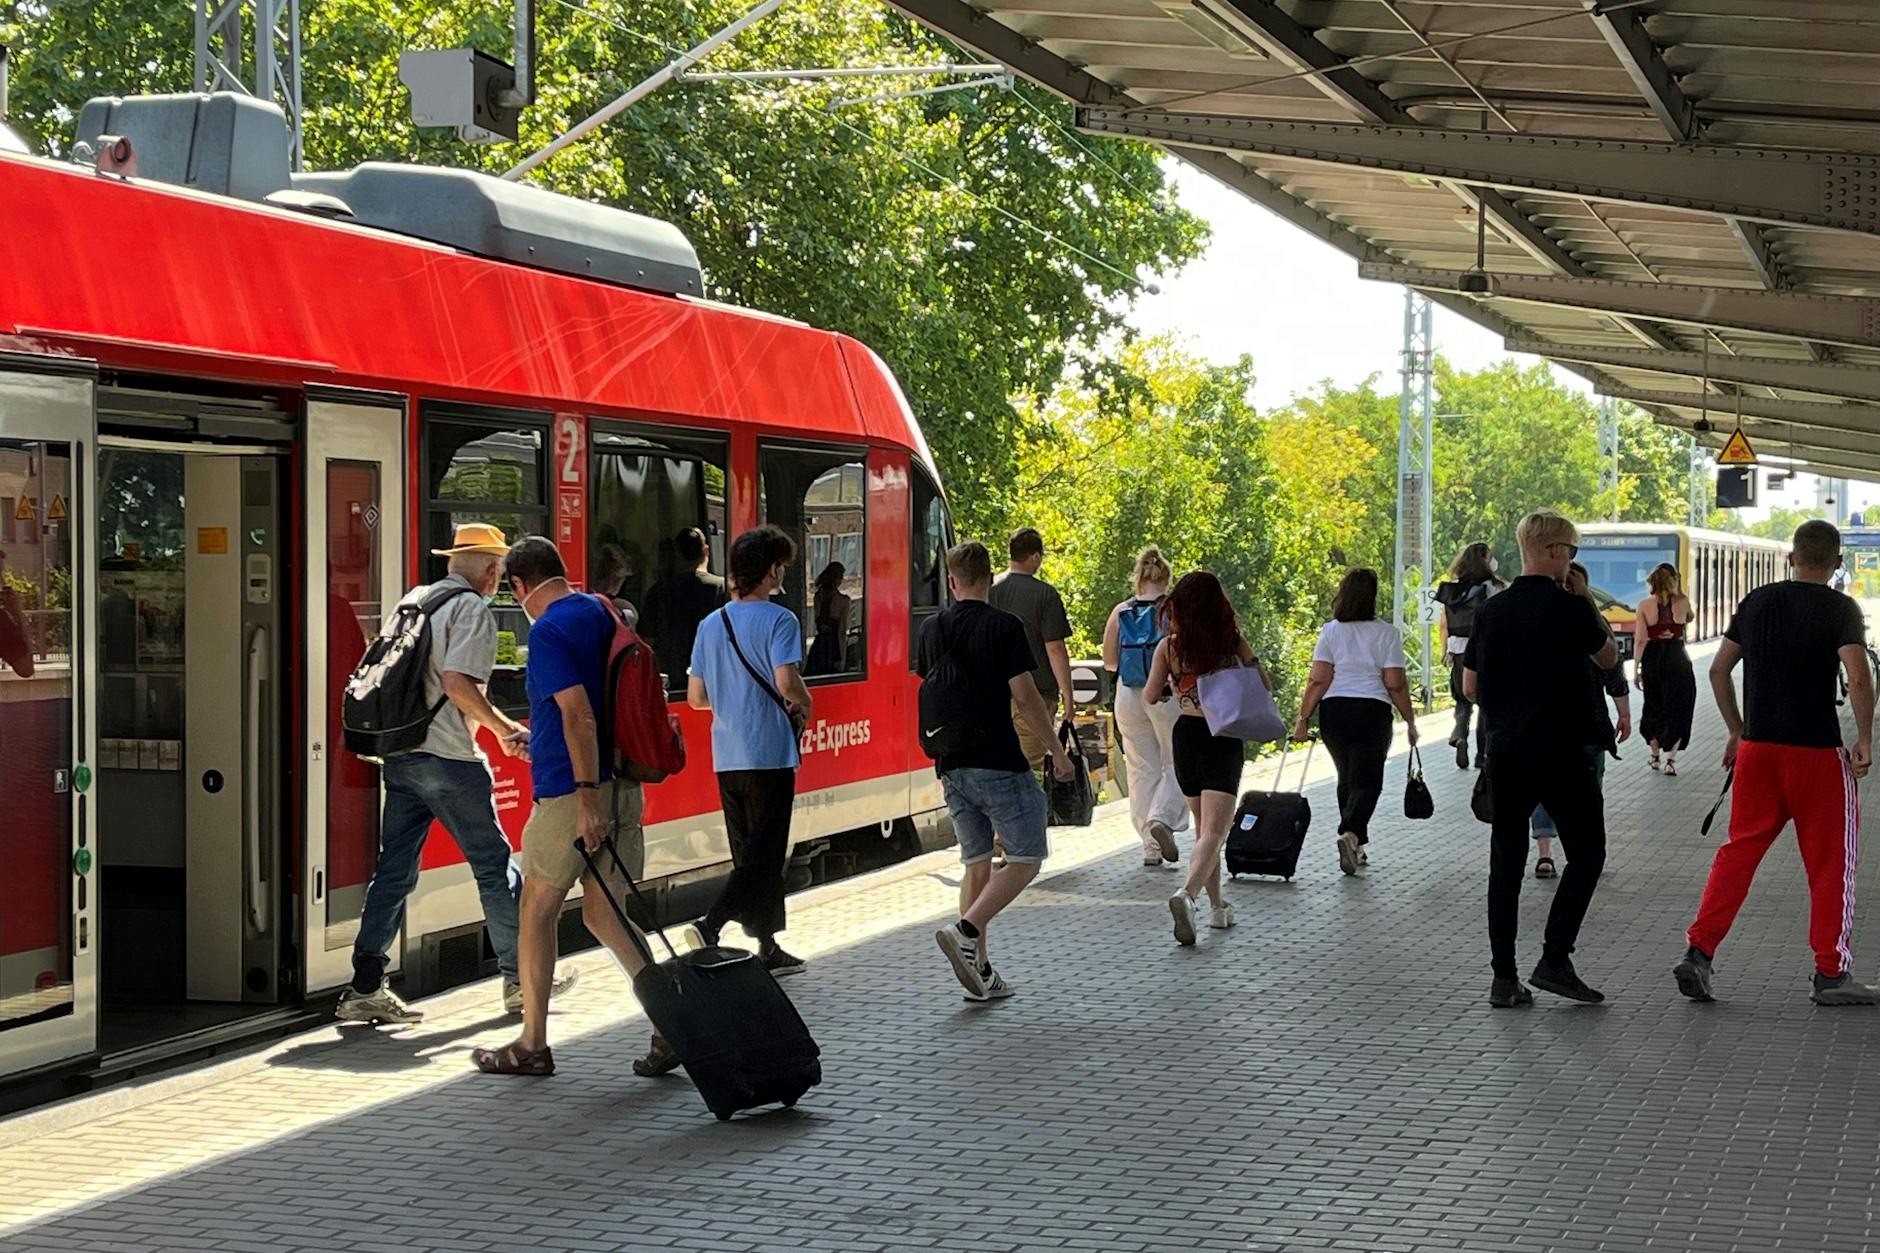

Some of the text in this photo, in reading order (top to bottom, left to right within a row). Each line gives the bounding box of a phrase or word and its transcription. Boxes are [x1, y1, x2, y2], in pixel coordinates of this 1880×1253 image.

[562, 419, 579, 482] 2
[1740, 469, 1754, 500] 1
[1425, 606, 1434, 622] 2
